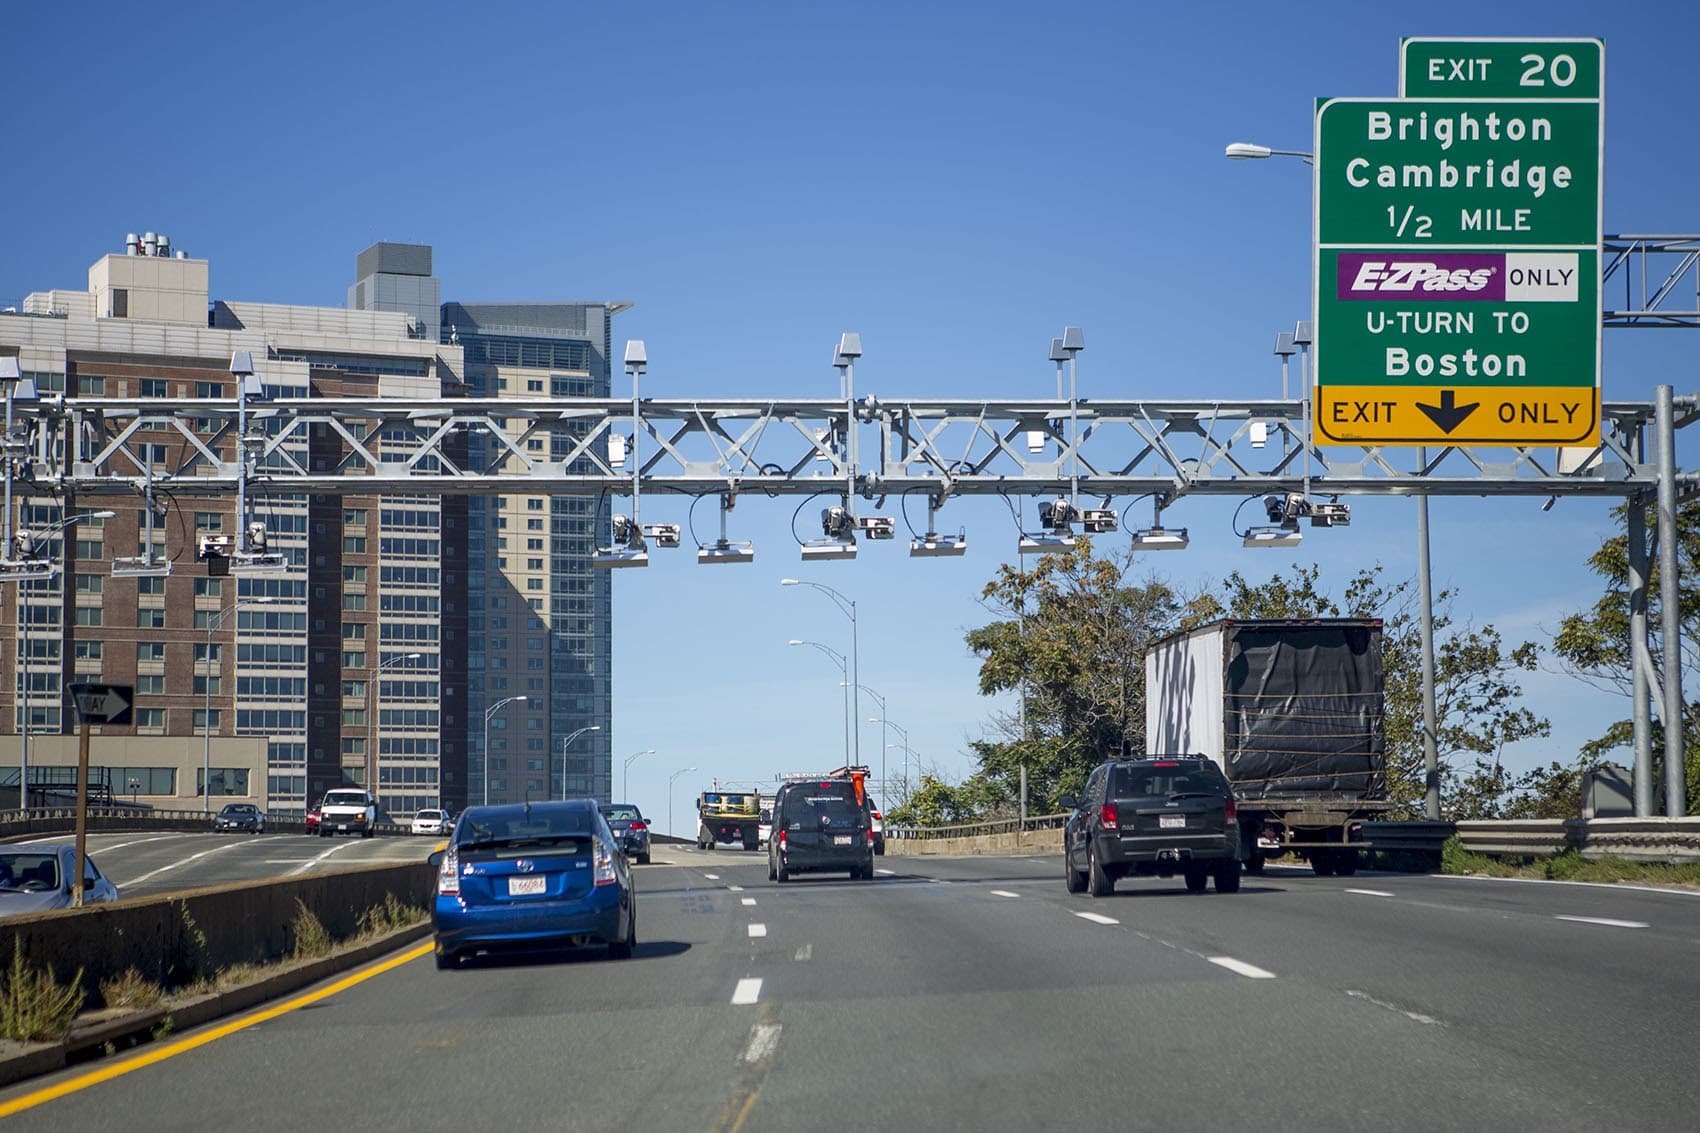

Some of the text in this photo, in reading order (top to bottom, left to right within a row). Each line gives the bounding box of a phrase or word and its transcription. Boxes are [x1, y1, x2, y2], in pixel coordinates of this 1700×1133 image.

[1428, 53, 1577, 87] EXIT 20
[1368, 111, 1552, 151] Brighton
[1346, 157, 1572, 198] Cambridge
[1461, 208, 1531, 231] MILE
[1509, 268, 1574, 286] ONLY
[1367, 311, 1530, 334] U-TURN TO
[1385, 347, 1526, 377] Boston
[1333, 401, 1581, 424] EXIT ONLY
